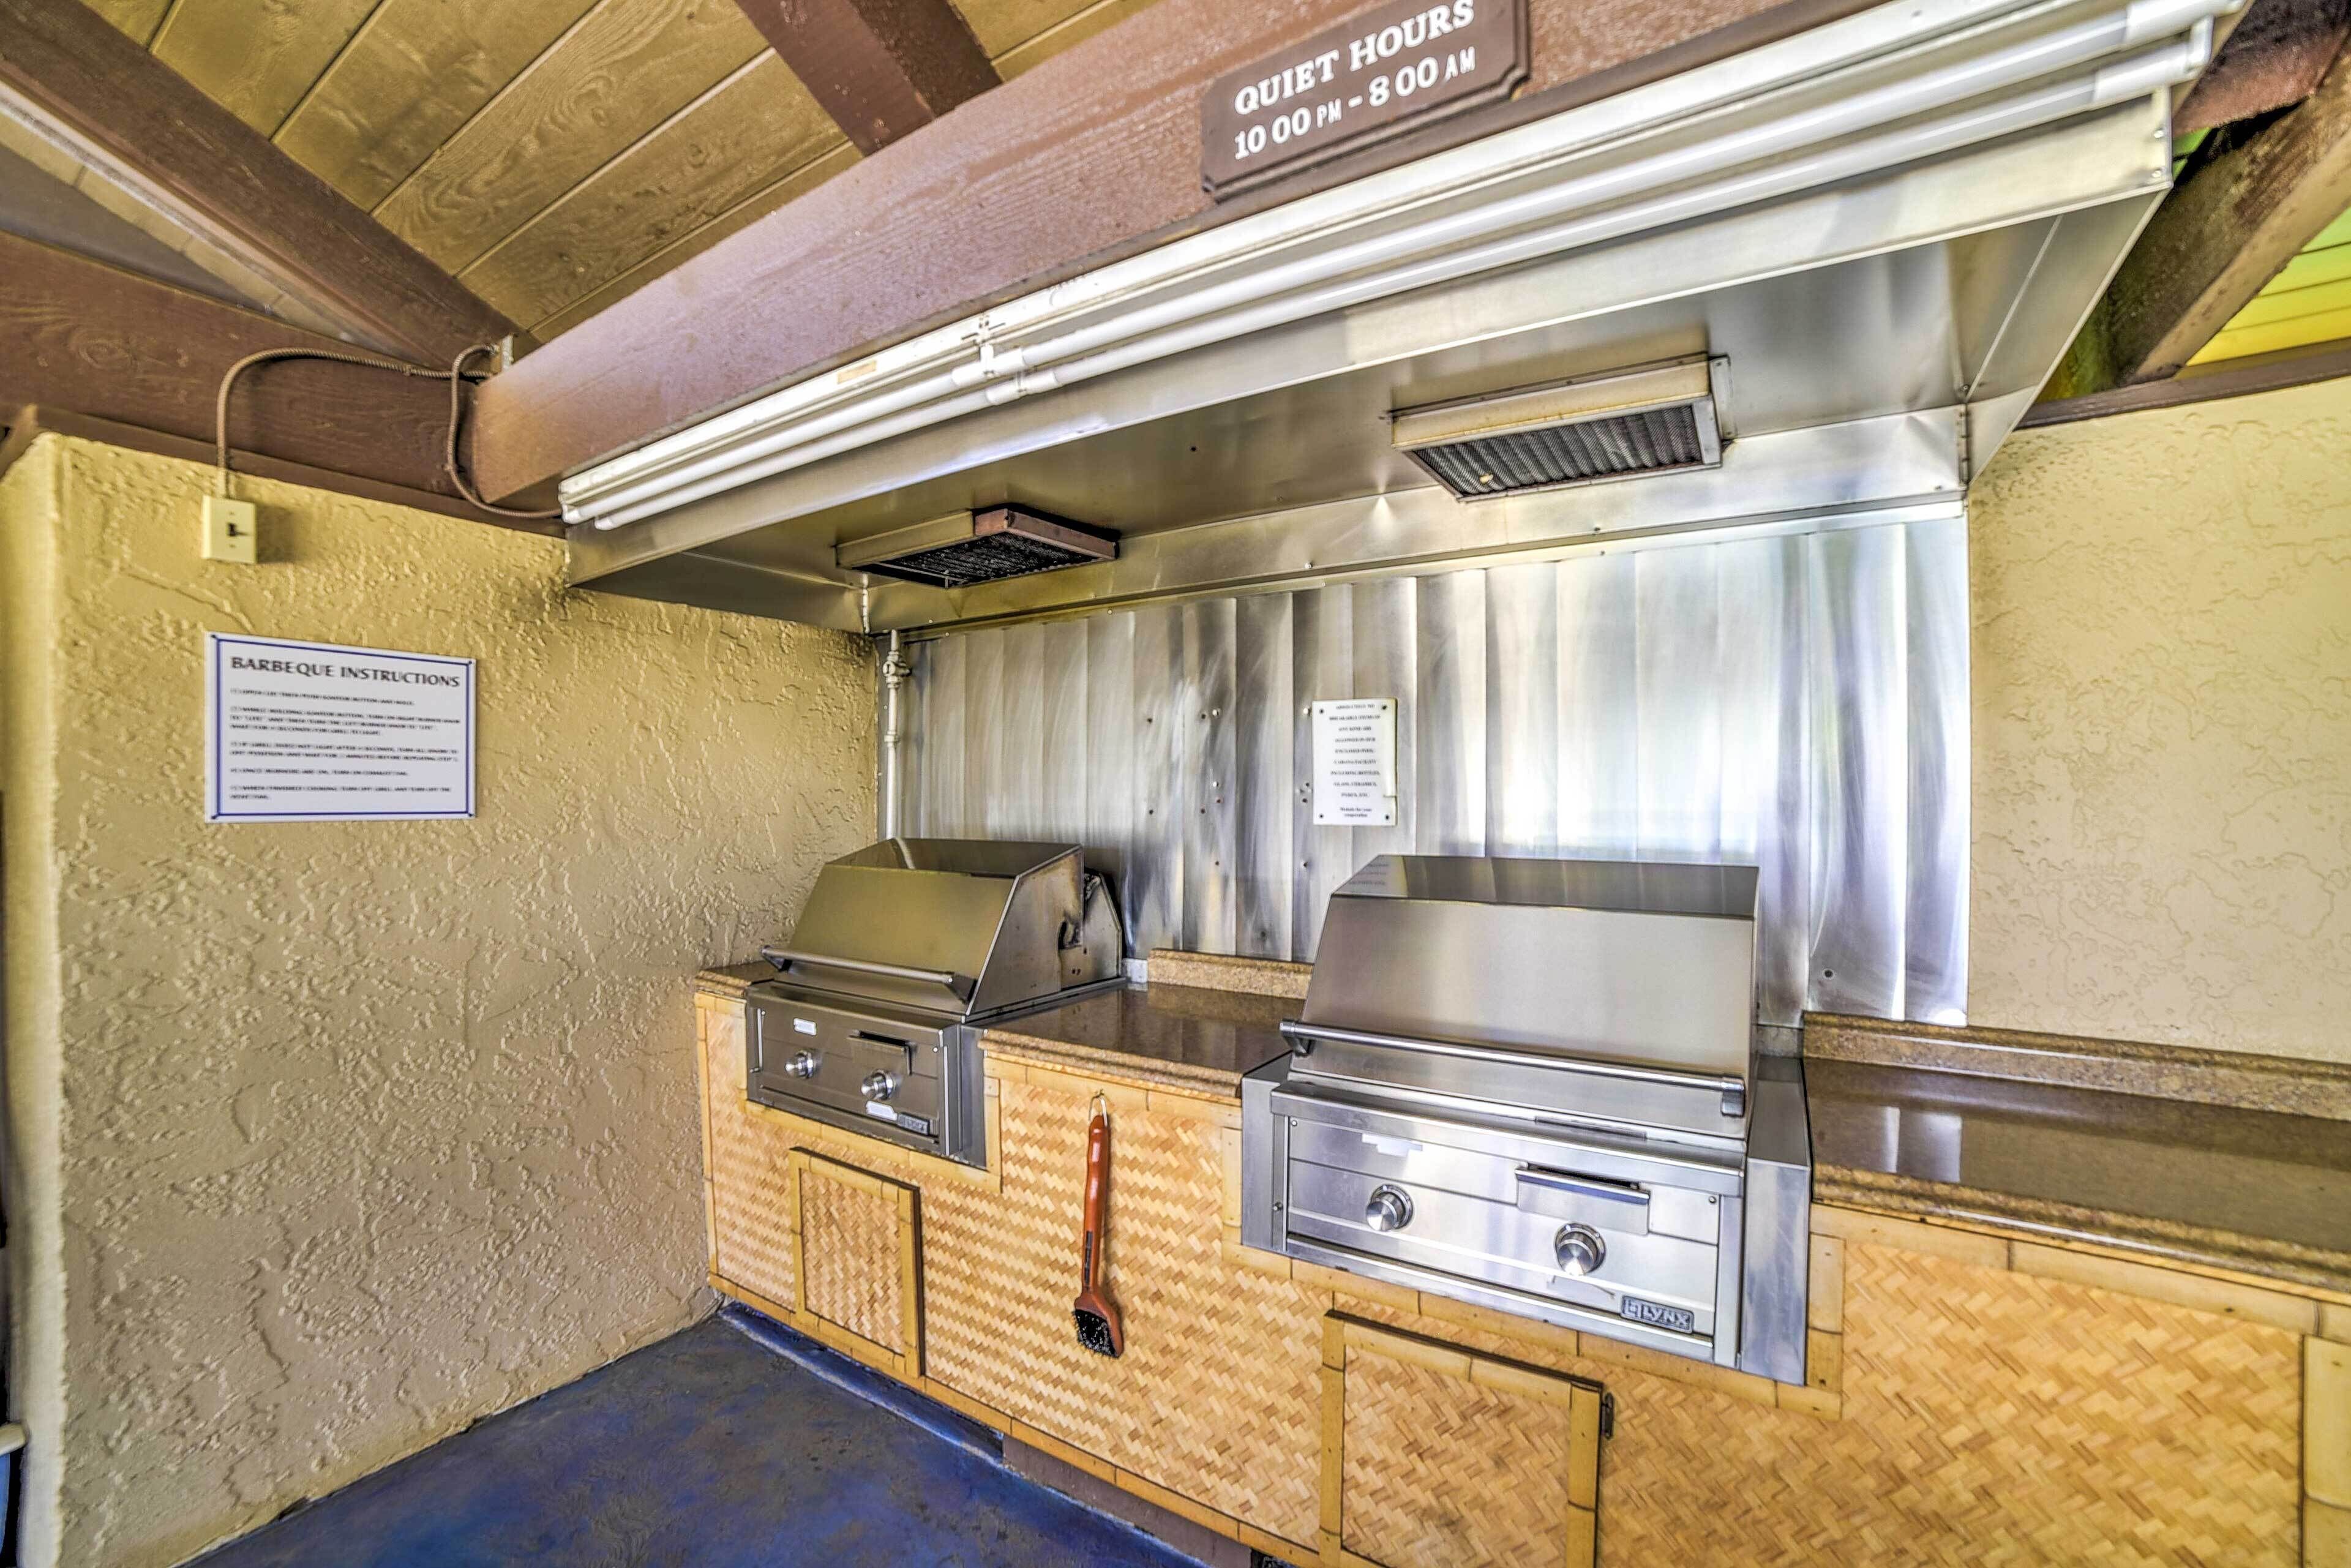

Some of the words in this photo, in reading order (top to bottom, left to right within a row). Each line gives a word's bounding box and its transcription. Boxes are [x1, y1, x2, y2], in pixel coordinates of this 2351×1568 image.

[1234, 49, 1340, 115] QUIET
[1349, 0, 1474, 72] HOURS
[1316, 98, 1343, 128] PM
[1445, 46, 1475, 80] AM
[231, 656, 335, 677] BARBEQUE
[340, 666, 460, 687] INSTRUCTIONS
[1643, 1305, 1690, 1328] LYNX
